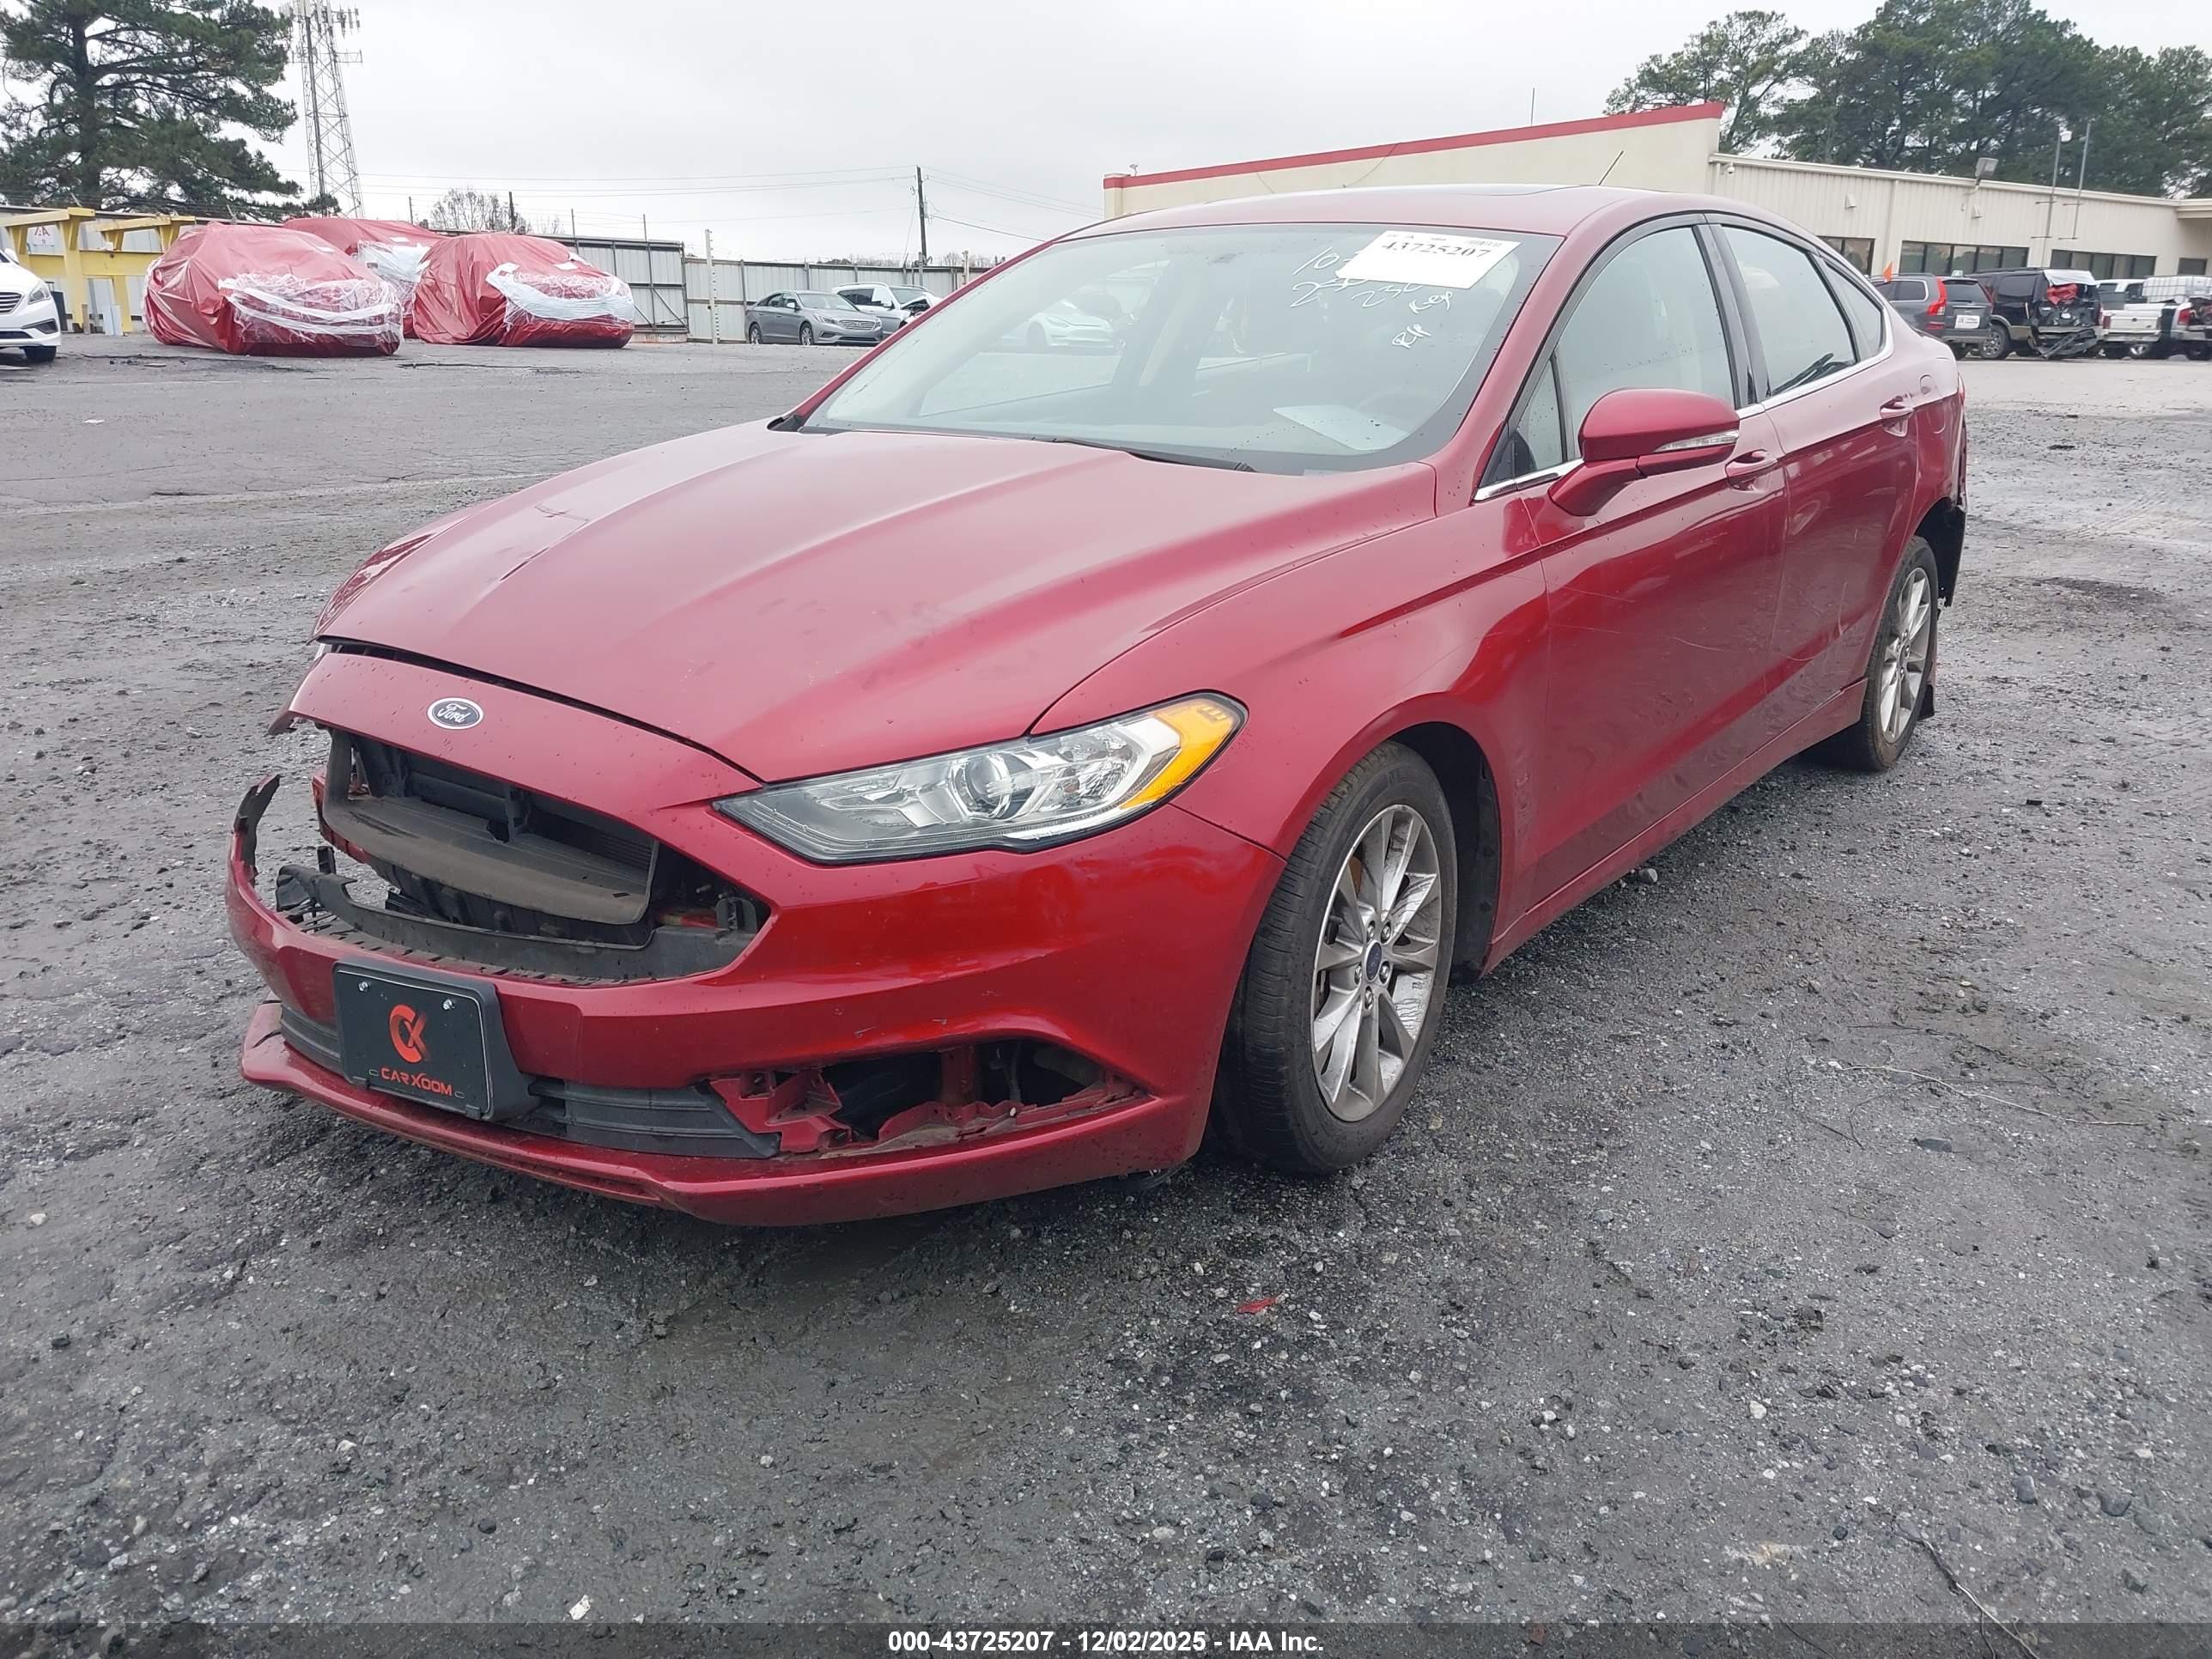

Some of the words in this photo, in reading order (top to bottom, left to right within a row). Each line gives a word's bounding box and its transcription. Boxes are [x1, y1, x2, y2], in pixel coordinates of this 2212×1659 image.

[1382, 241, 1491, 258] 43725207
[437, 702, 471, 723] Ford
[380, 1067, 453, 1097] CARXOOM
